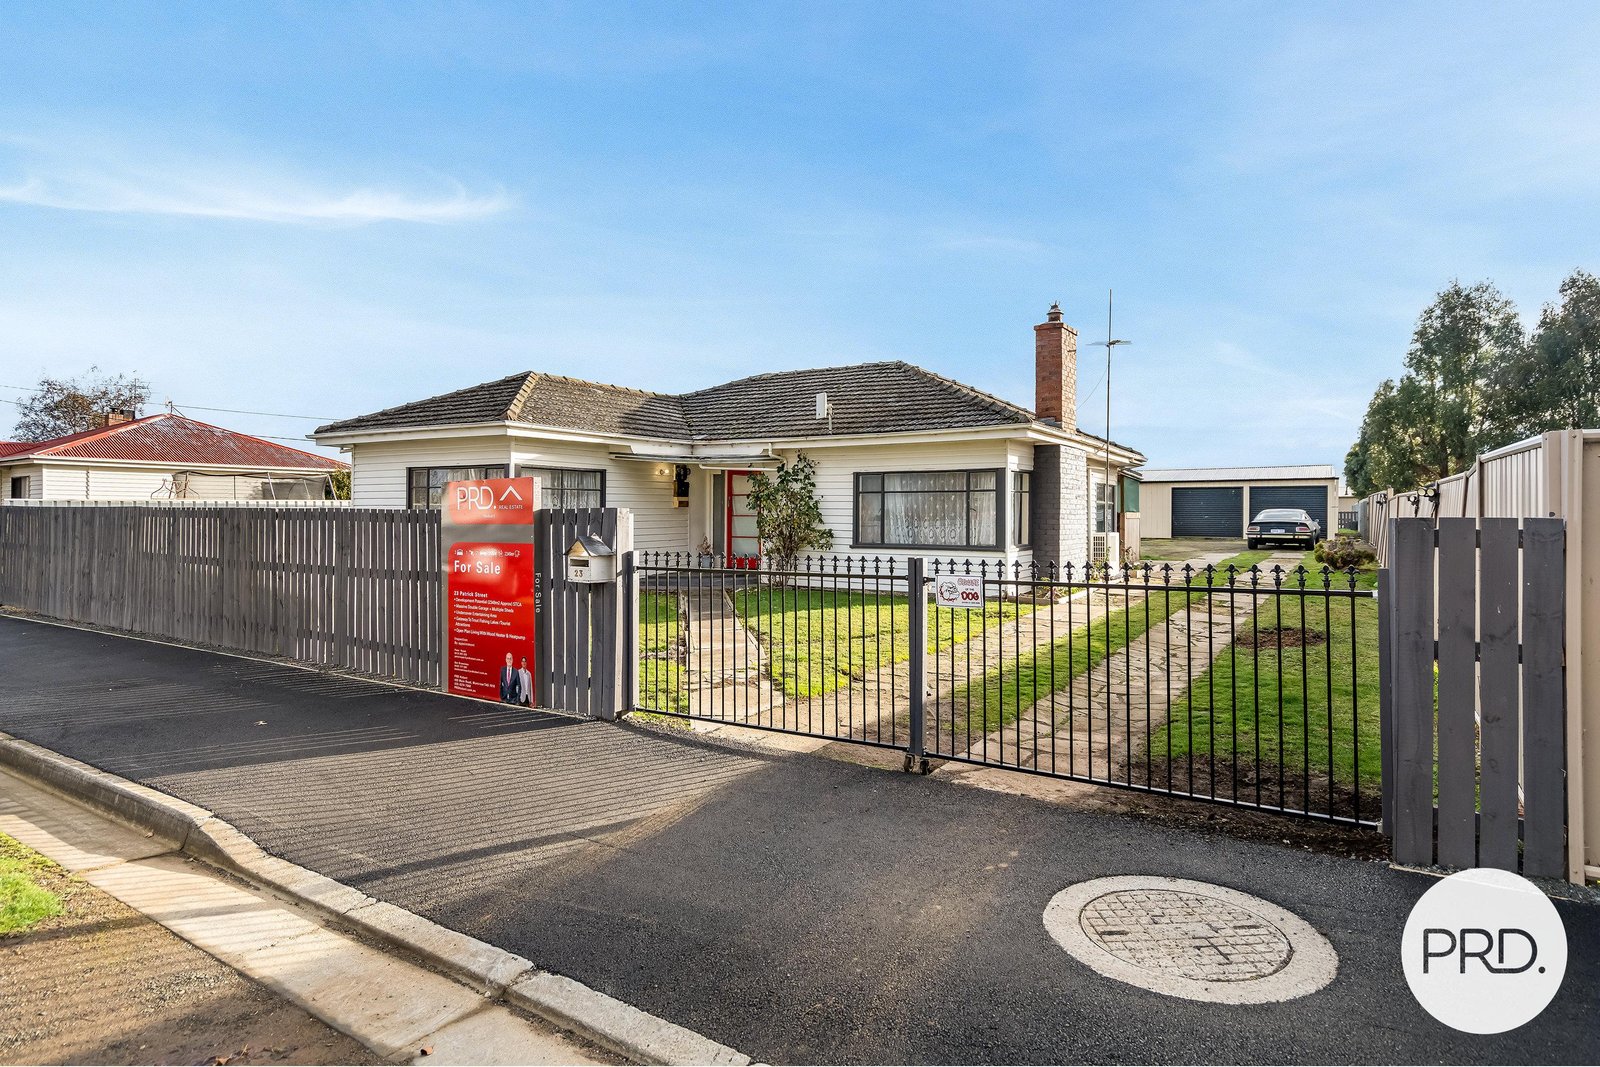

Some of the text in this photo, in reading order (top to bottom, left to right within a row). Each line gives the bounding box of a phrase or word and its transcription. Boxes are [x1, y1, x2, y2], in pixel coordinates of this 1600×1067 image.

[454, 560, 501, 575] For Sale
[574, 569, 583, 577] 23
[961, 591, 979, 601] DOG
